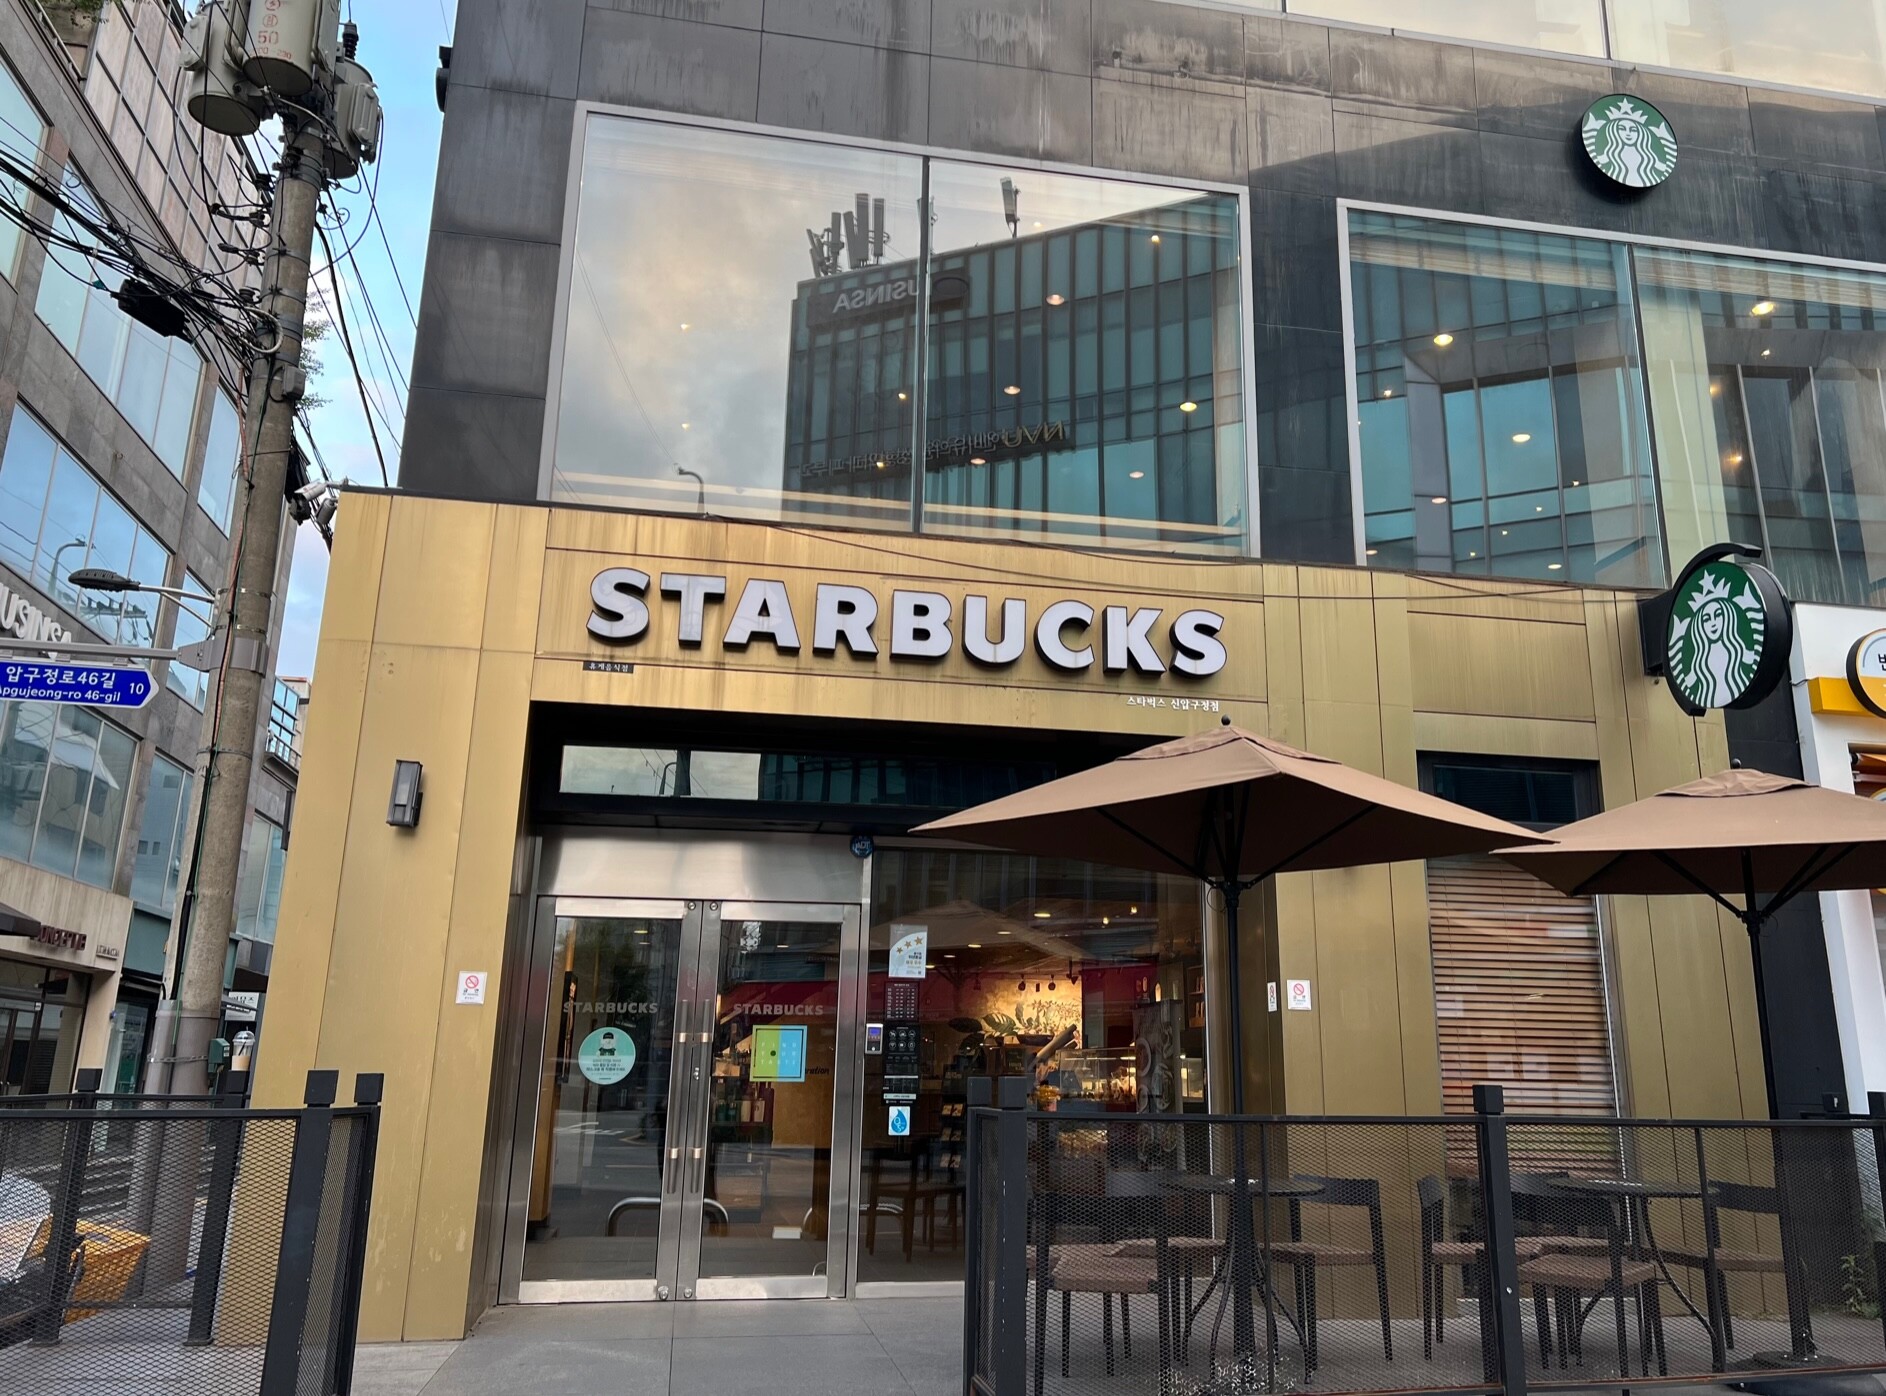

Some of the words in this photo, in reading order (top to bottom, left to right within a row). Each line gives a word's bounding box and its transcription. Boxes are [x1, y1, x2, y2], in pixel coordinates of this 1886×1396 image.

[258, 30, 279, 45] 50
[0, 583, 72, 643] USINS
[586, 567, 1227, 677] STARBUCKS
[6, 665, 116, 689] 압구정로46길
[129, 682, 145, 695] 10
[0, 684, 82, 700] pgujeong-ro
[84, 689, 121, 703] 46-gil
[1126, 696, 1167, 708] 스타벅스
[1170, 698, 1219, 712] 신압구정점
[563, 1001, 658, 1014] STARBUCKS
[733, 1003, 824, 1016] STARBUCKS
